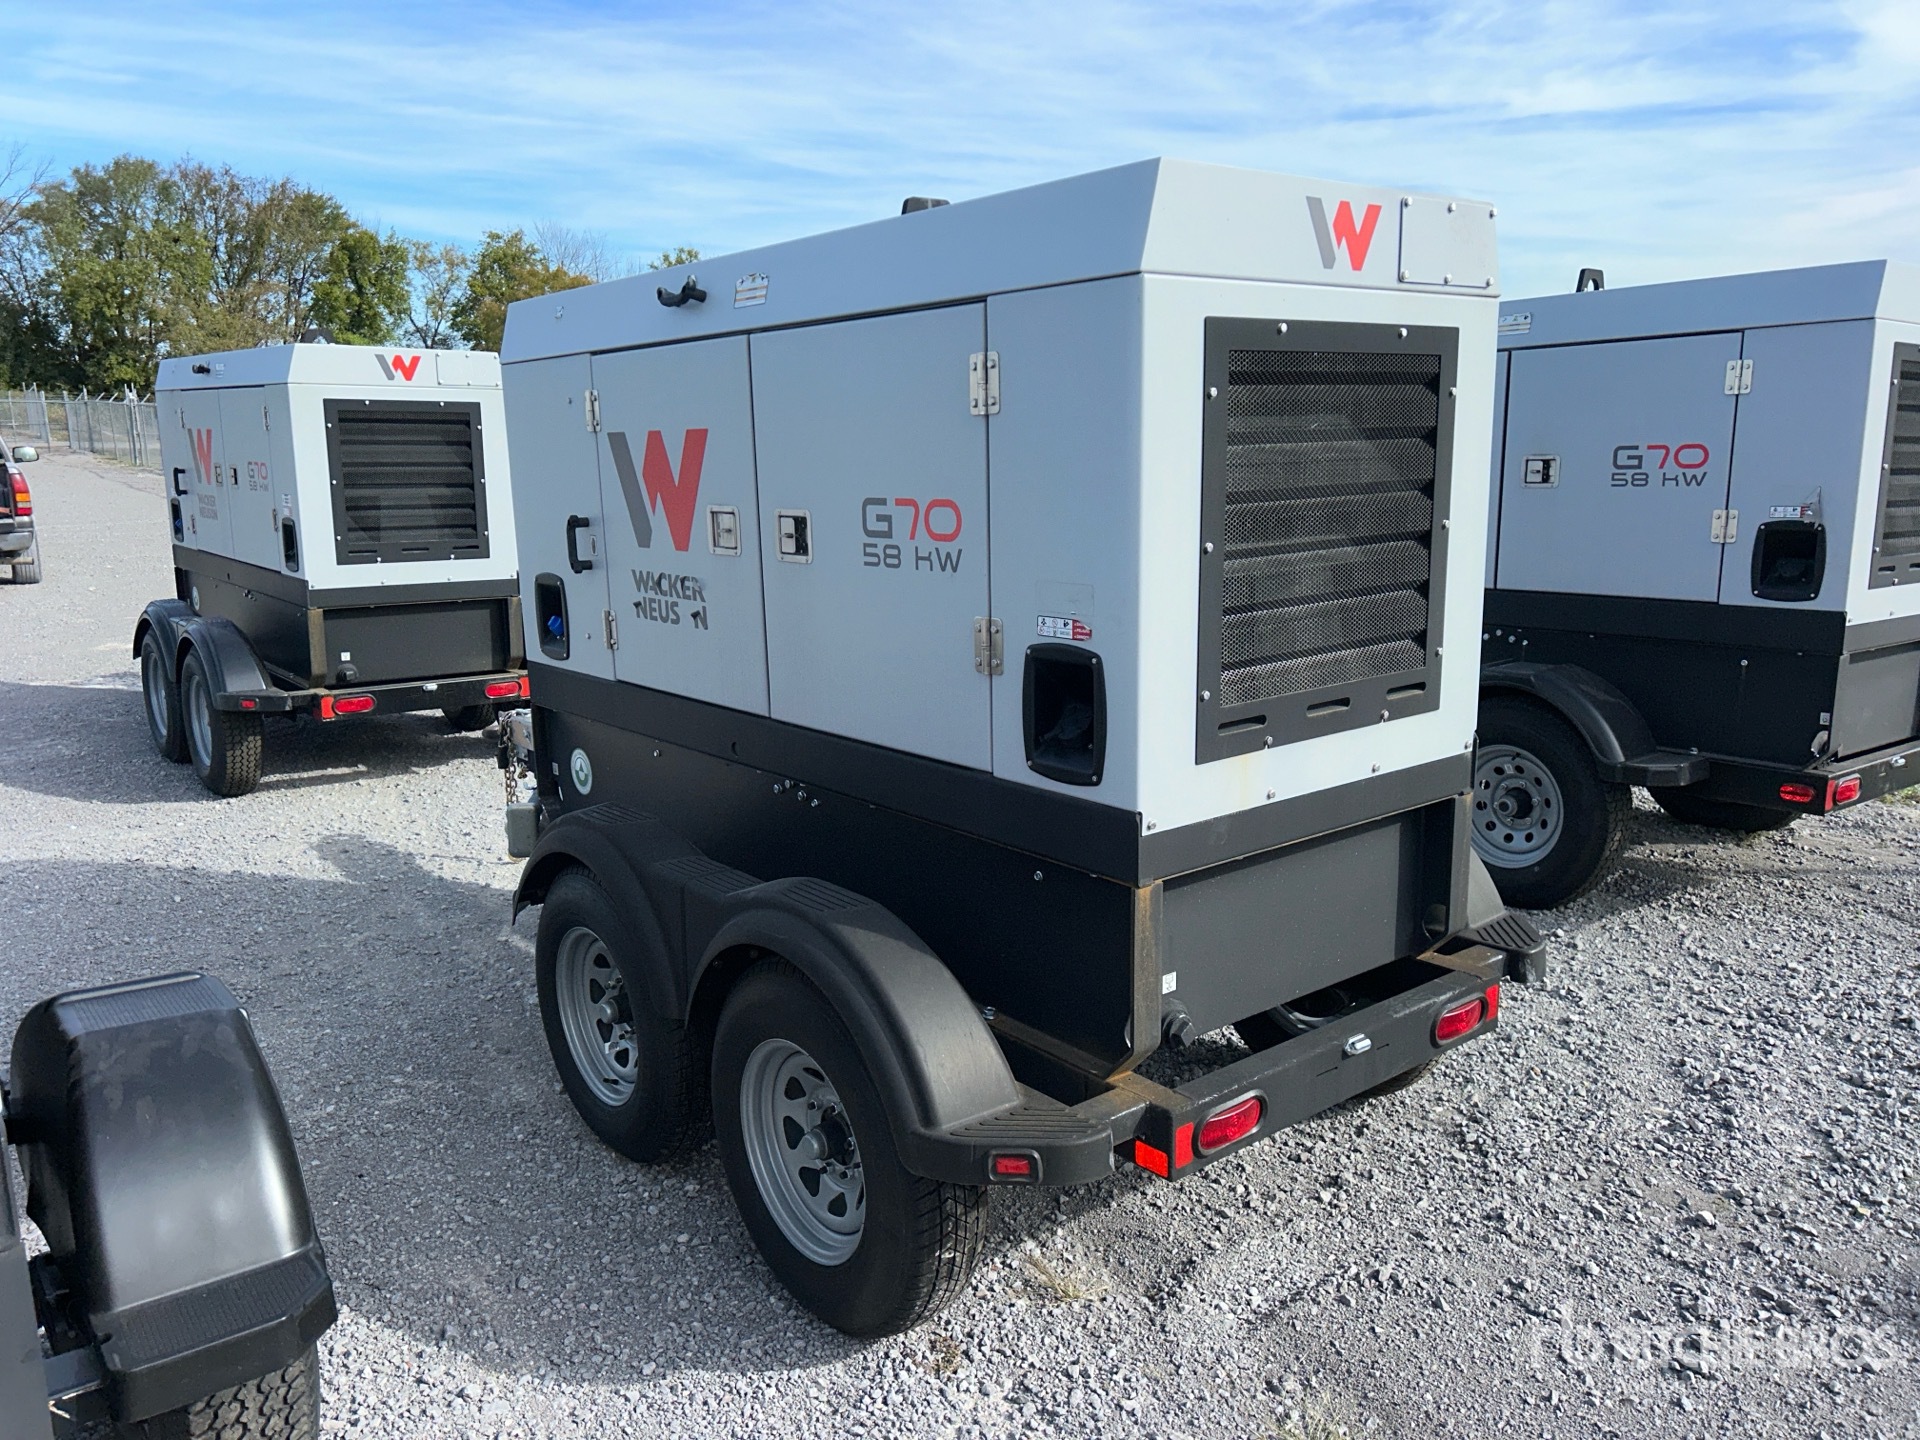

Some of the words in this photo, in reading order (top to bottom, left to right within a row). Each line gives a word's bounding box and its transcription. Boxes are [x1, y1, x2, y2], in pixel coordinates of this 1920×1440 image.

[1612, 443, 1709, 470] G70
[247, 461, 268, 480] G70
[1610, 472, 1649, 487] 58
[861, 497, 963, 543] G70
[863, 542, 902, 569] 58
[631, 569, 706, 603] WACKER
